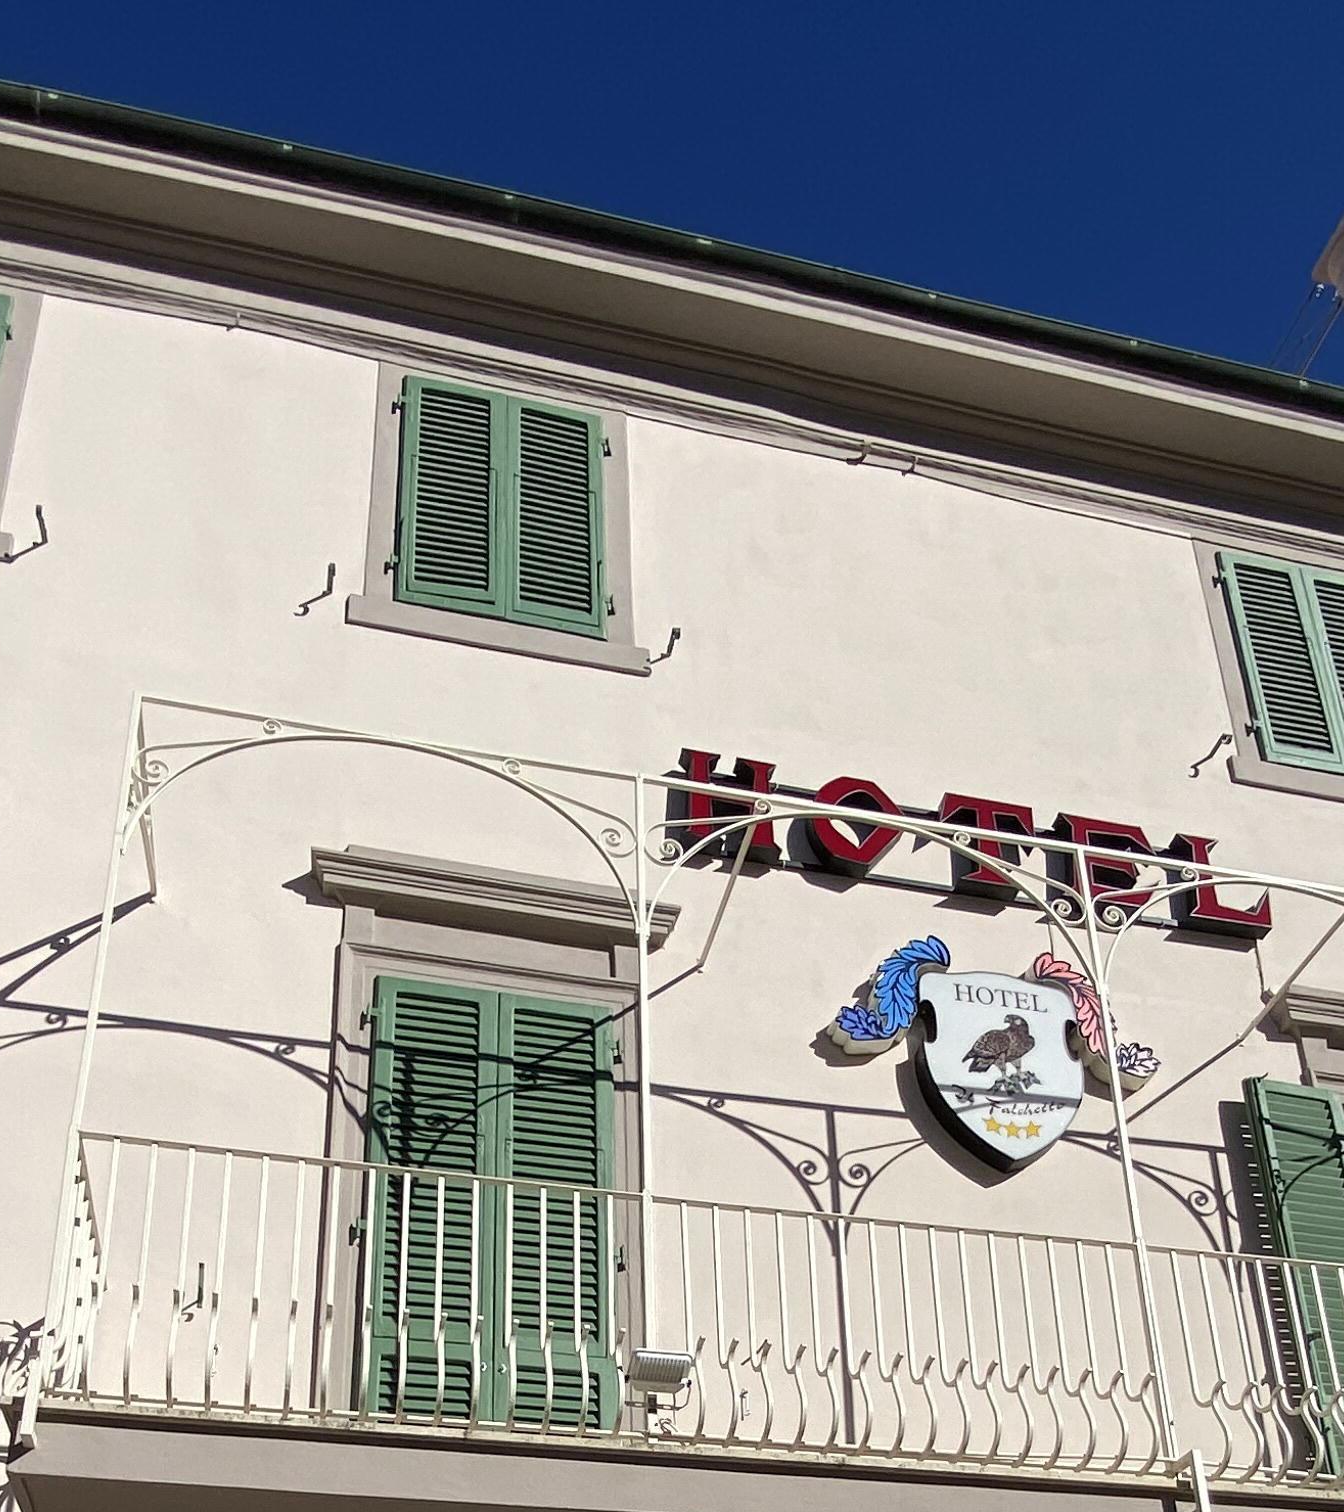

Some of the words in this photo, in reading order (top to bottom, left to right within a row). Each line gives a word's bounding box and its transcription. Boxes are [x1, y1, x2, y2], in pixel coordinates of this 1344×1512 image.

[670, 747, 1273, 938] HOTEL
[952, 982, 1048, 1013] HOTEL
[985, 1096, 1066, 1116] Falchetto
